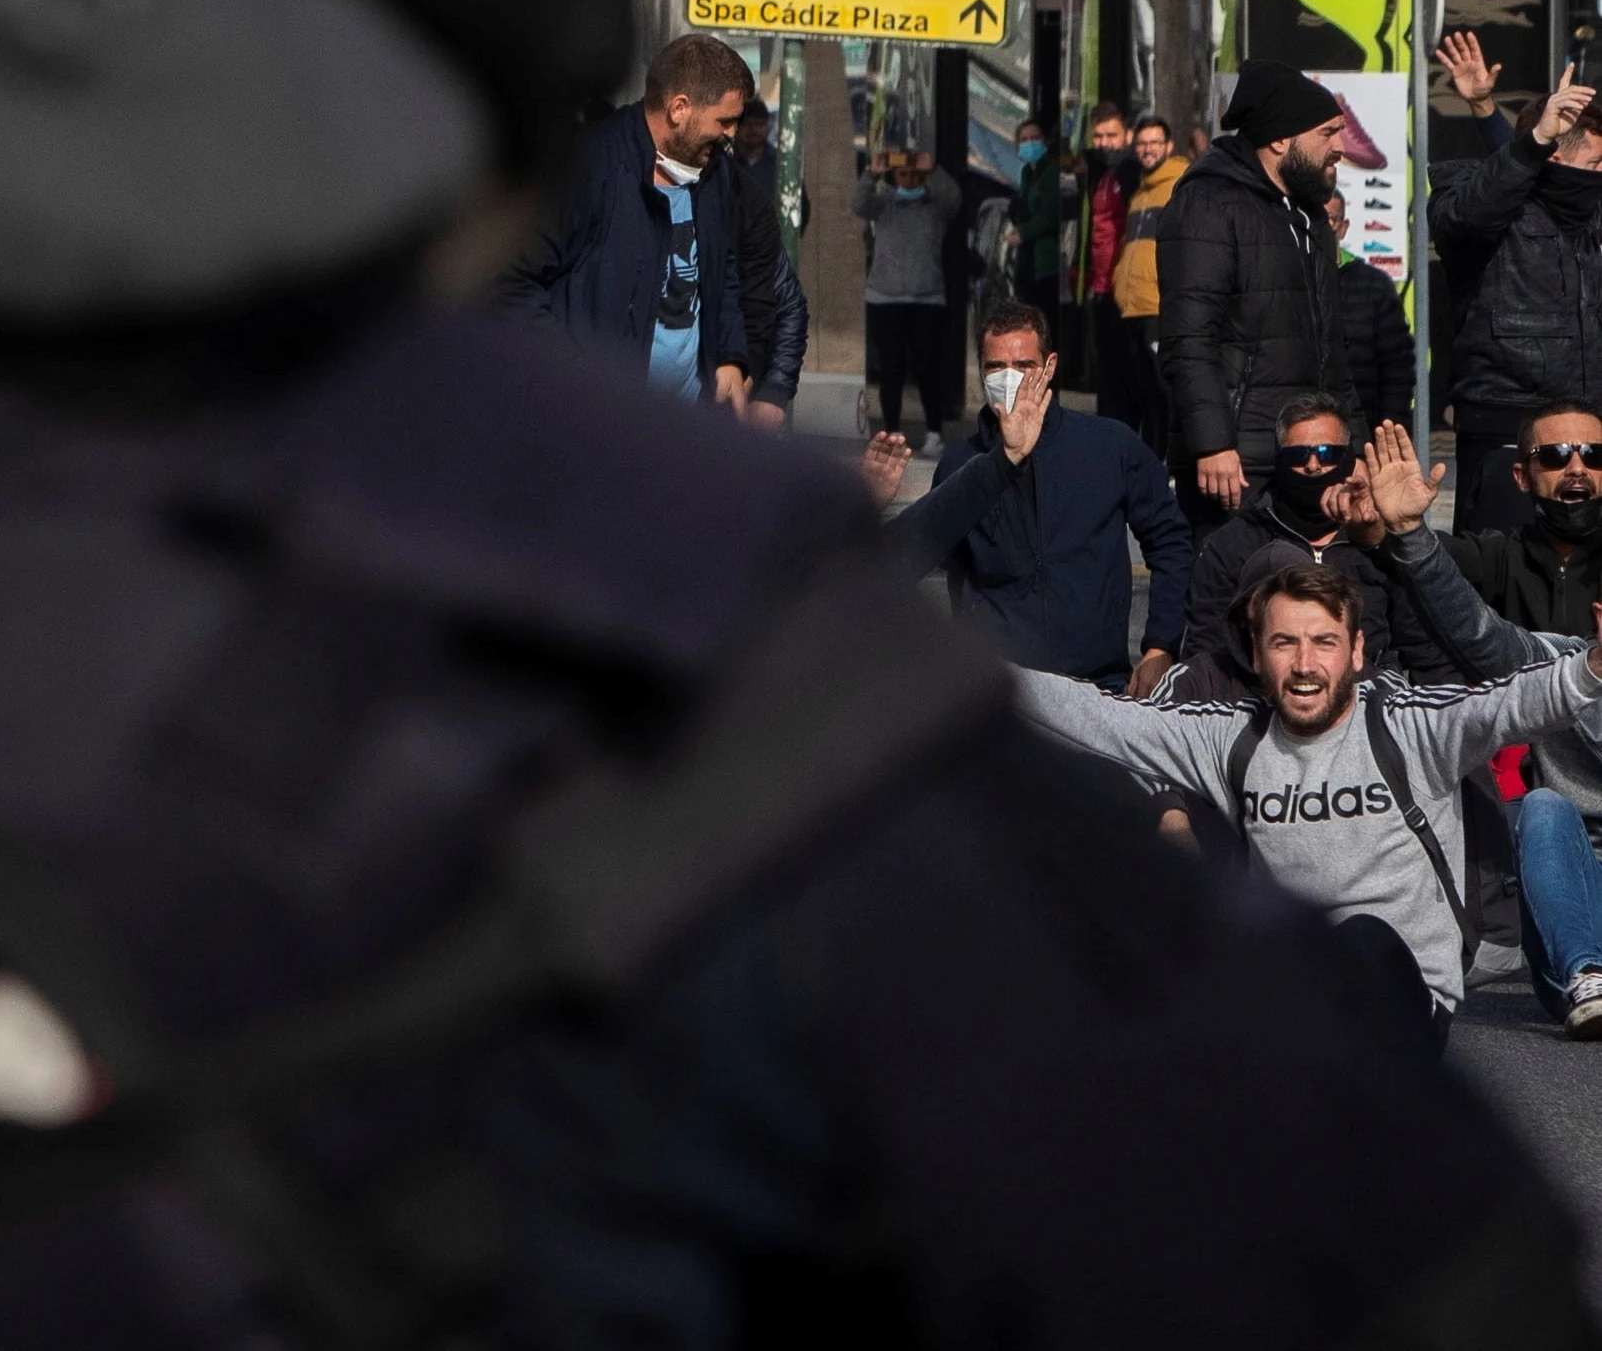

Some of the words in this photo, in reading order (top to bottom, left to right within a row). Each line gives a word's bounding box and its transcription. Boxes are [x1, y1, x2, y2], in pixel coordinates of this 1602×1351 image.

[759, 1, 840, 28] Cádiz
[852, 6, 929, 33] Plaza
[1243, 780, 1393, 824] adidas
